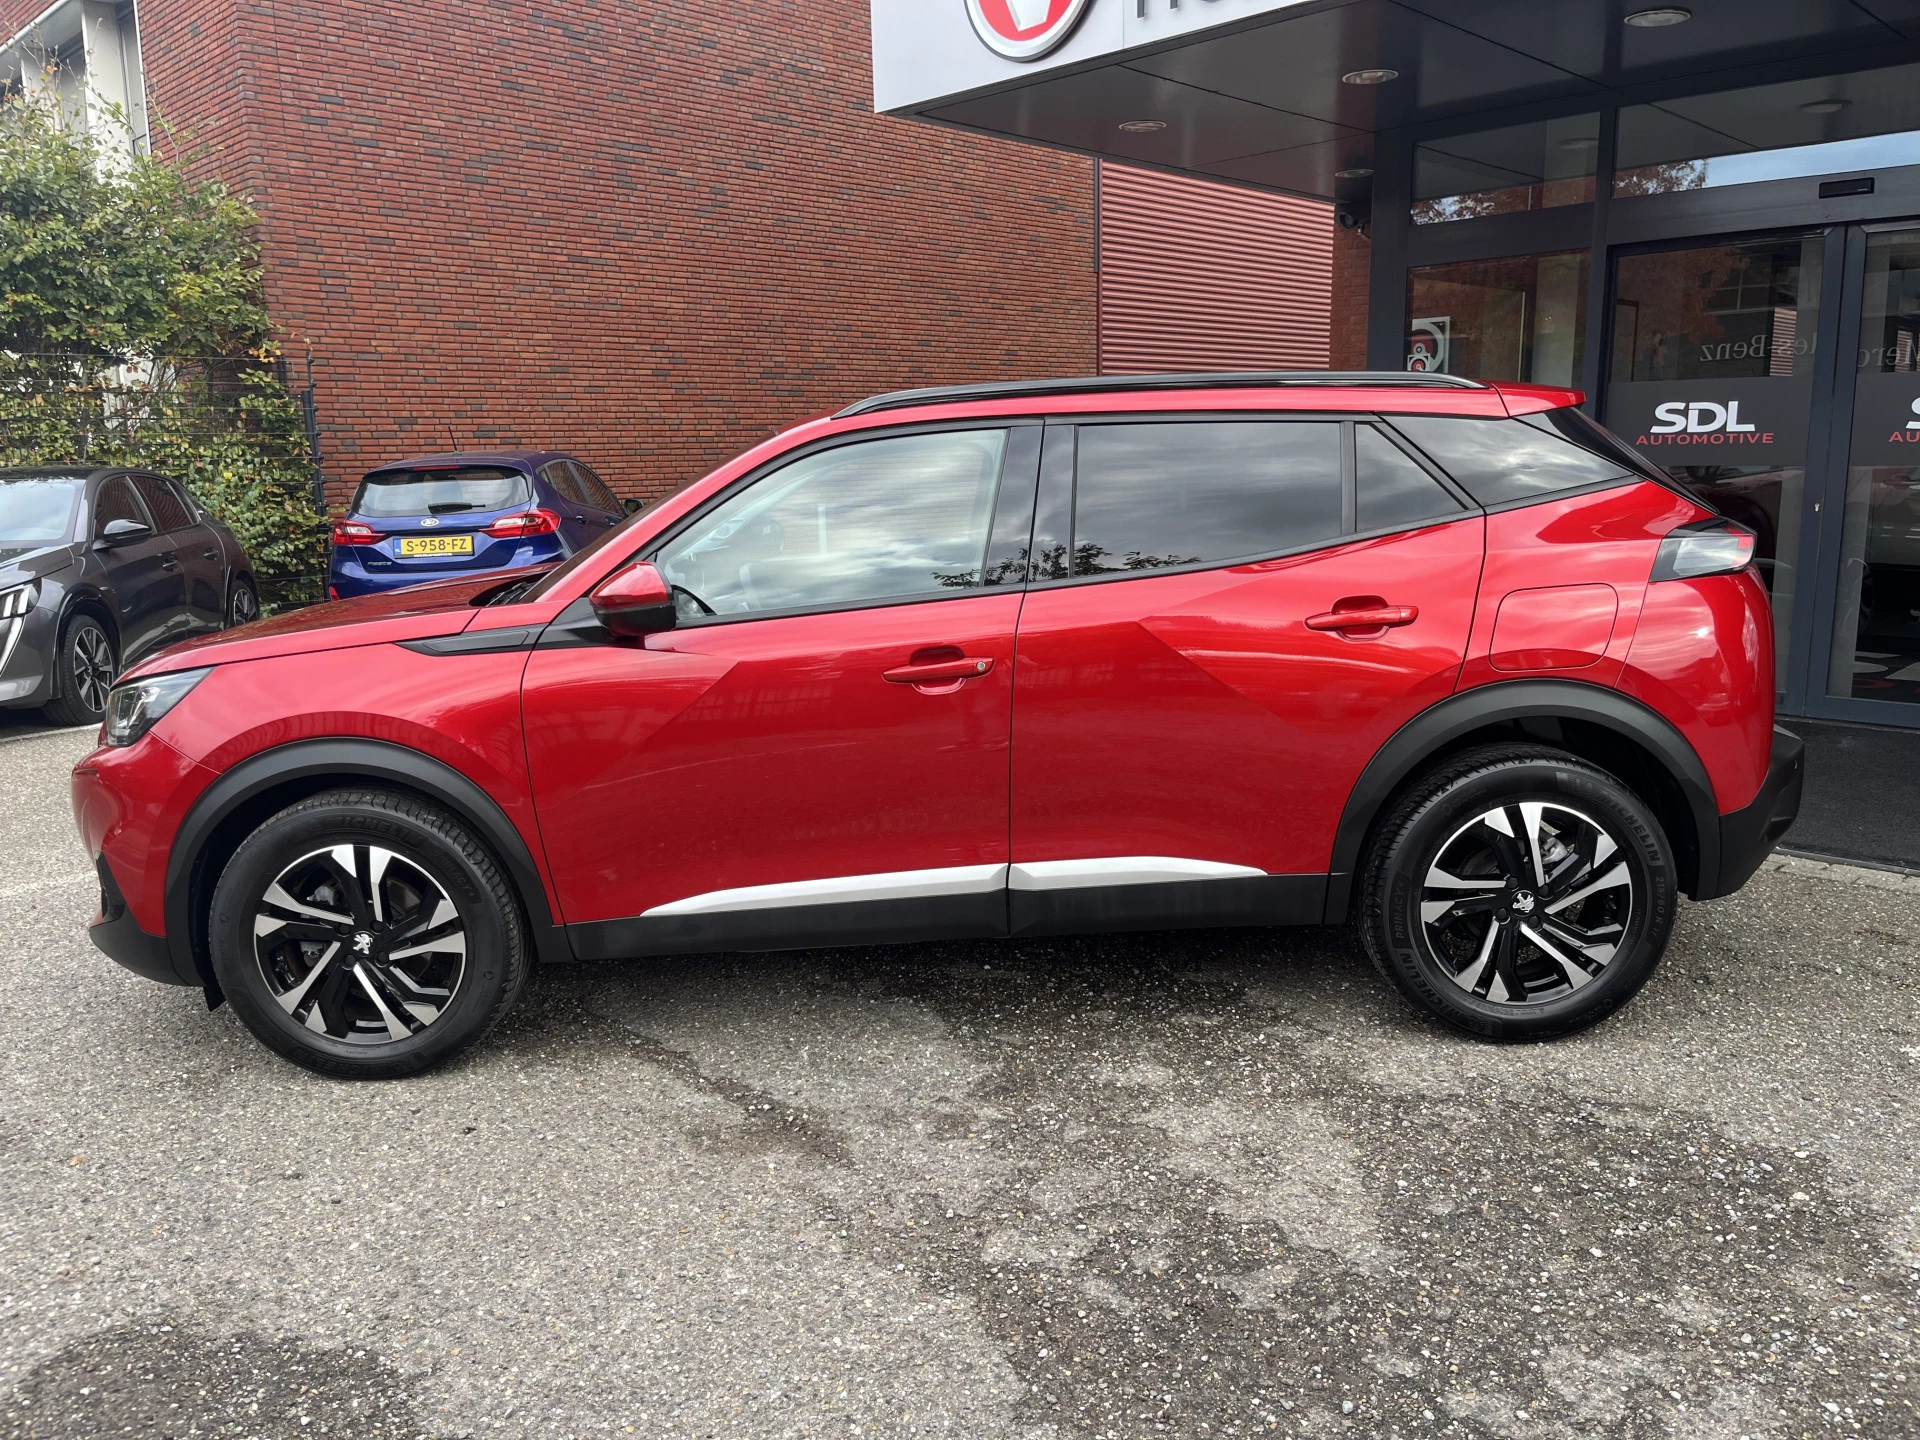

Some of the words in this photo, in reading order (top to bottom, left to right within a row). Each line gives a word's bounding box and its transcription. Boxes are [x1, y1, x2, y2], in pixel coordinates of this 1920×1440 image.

[1650, 401, 1755, 433] SDL
[1636, 433, 1774, 445] AUTOMOTIVE
[406, 538, 467, 552] S-958-FZ
